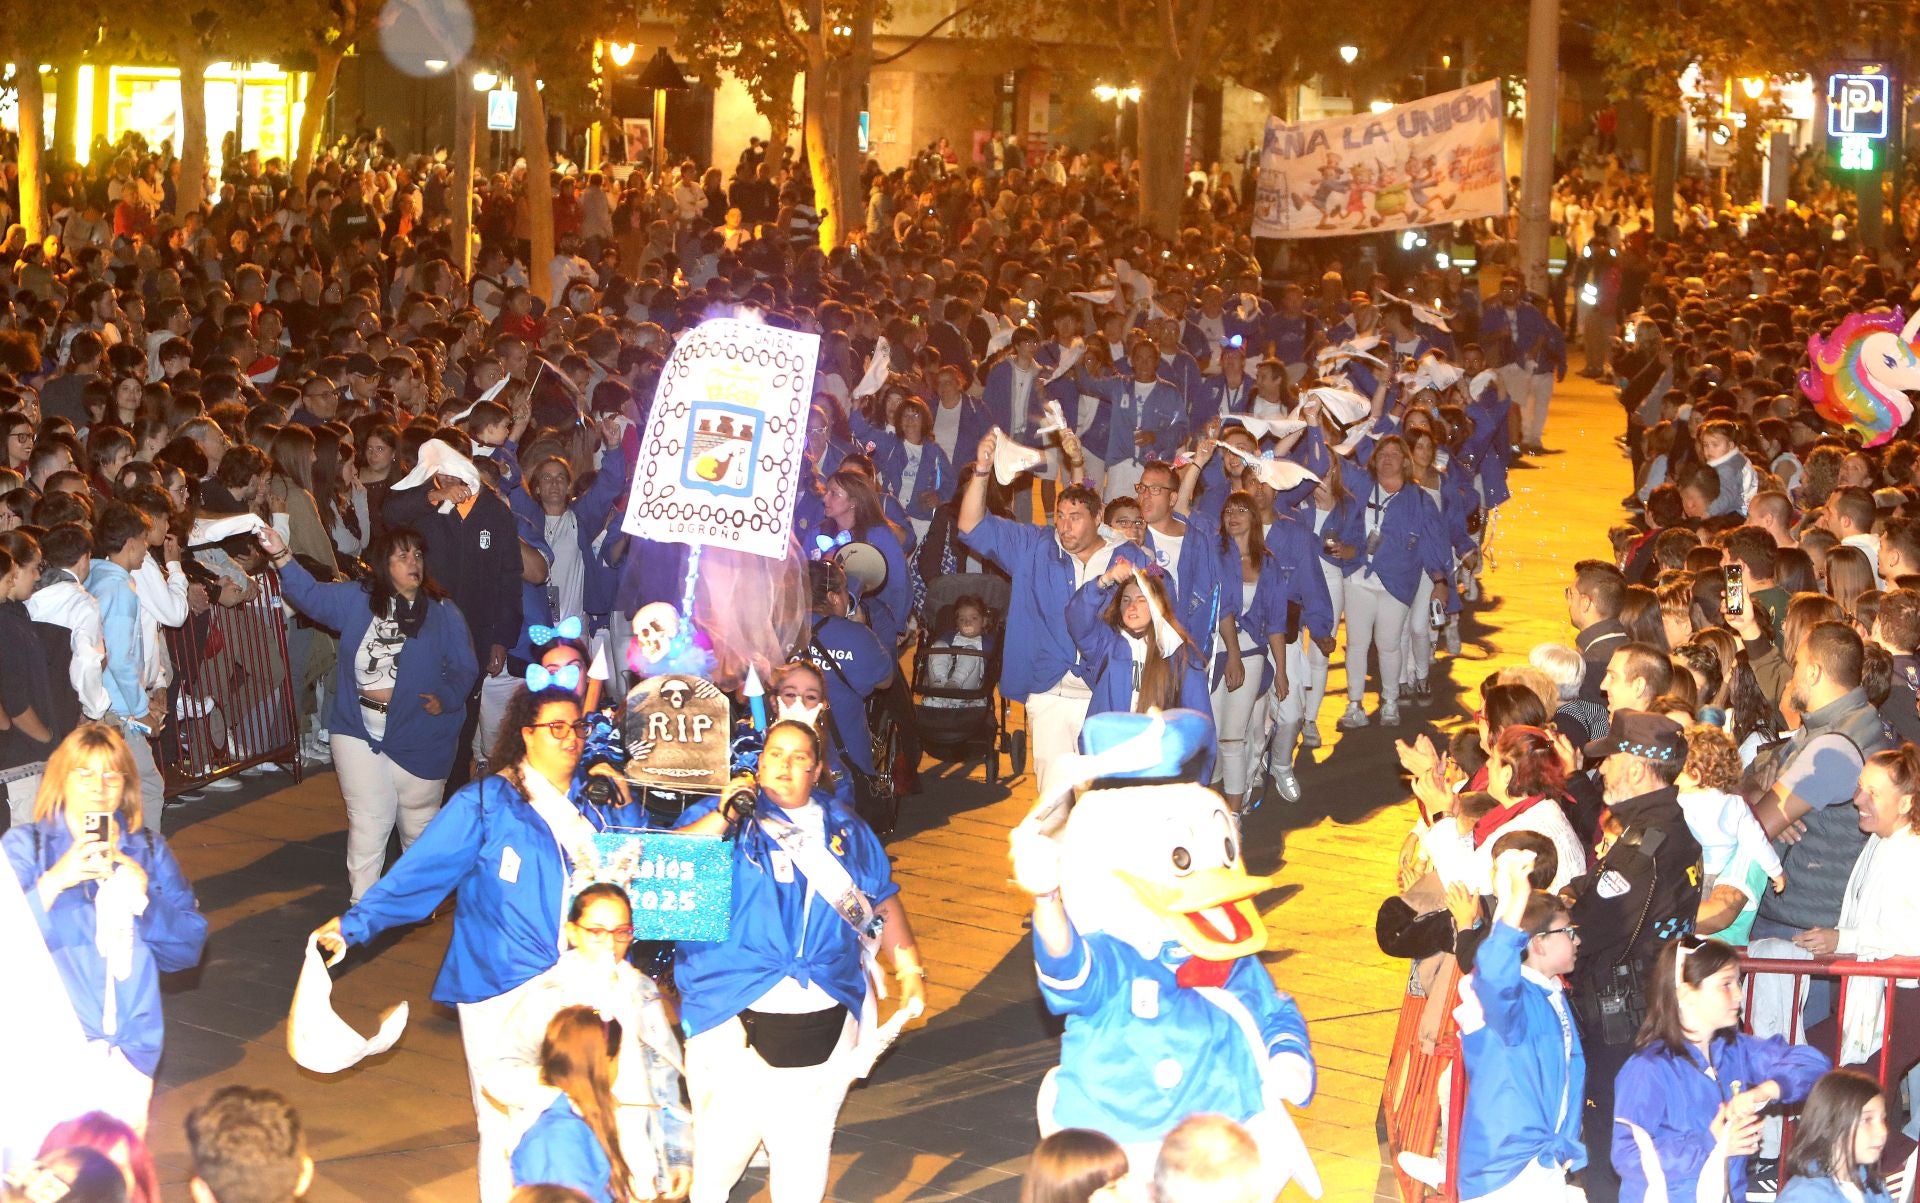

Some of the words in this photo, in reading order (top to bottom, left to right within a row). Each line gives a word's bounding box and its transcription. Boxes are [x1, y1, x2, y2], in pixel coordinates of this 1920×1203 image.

[1343, 121, 1390, 150] LA
[1397, 88, 1500, 139] UNIÓN
[668, 522, 741, 542] LOGROÑO
[647, 711, 714, 743] RIP
[629, 888, 697, 912] 2025
